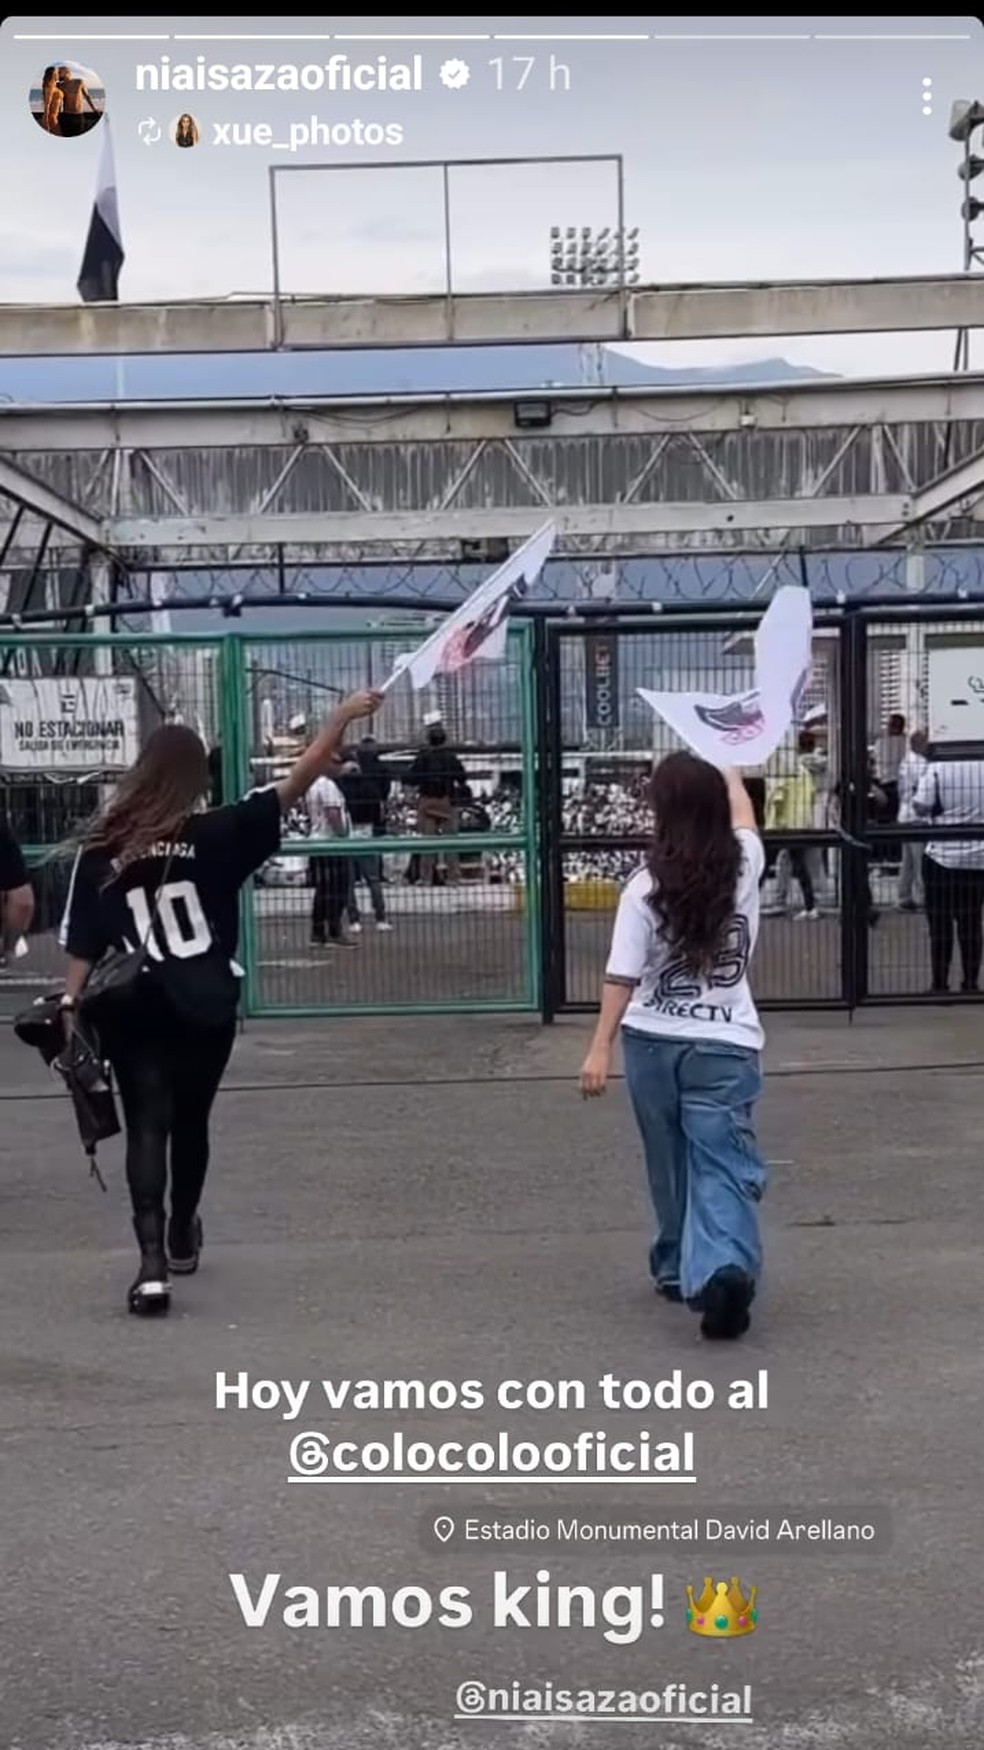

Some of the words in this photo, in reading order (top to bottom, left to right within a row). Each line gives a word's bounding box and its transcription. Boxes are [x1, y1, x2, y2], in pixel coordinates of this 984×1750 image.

[15, 720, 34, 739] NO
[40, 719, 125, 738] ESTACIONAR
[122, 880, 213, 962] 10
